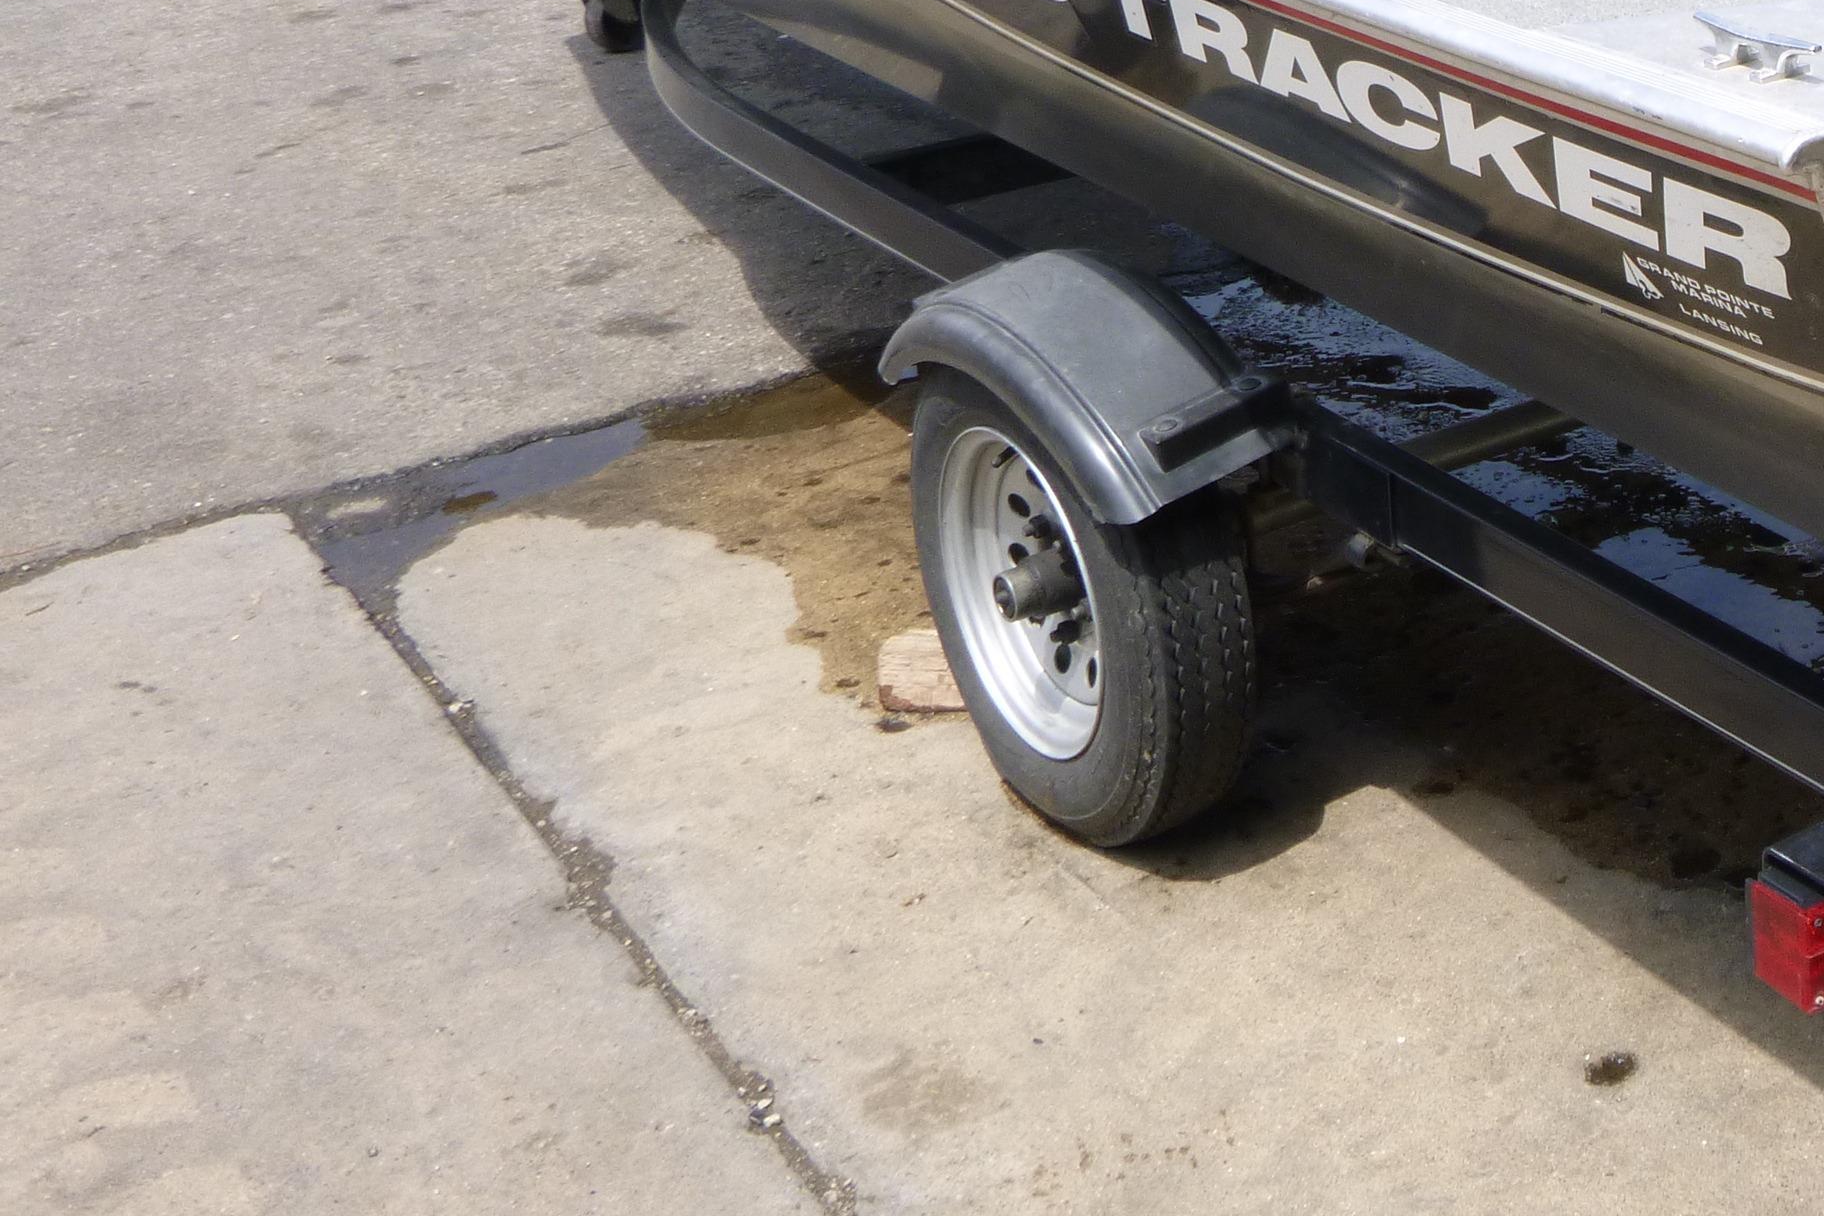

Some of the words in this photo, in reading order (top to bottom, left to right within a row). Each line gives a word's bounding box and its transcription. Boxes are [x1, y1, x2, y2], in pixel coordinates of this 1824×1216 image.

[1637, 257, 1701, 291] GRAND
[1704, 286, 1776, 319] POINTE
[1671, 281, 1747, 319] MARINA
[1678, 303, 1764, 345] LANSING
